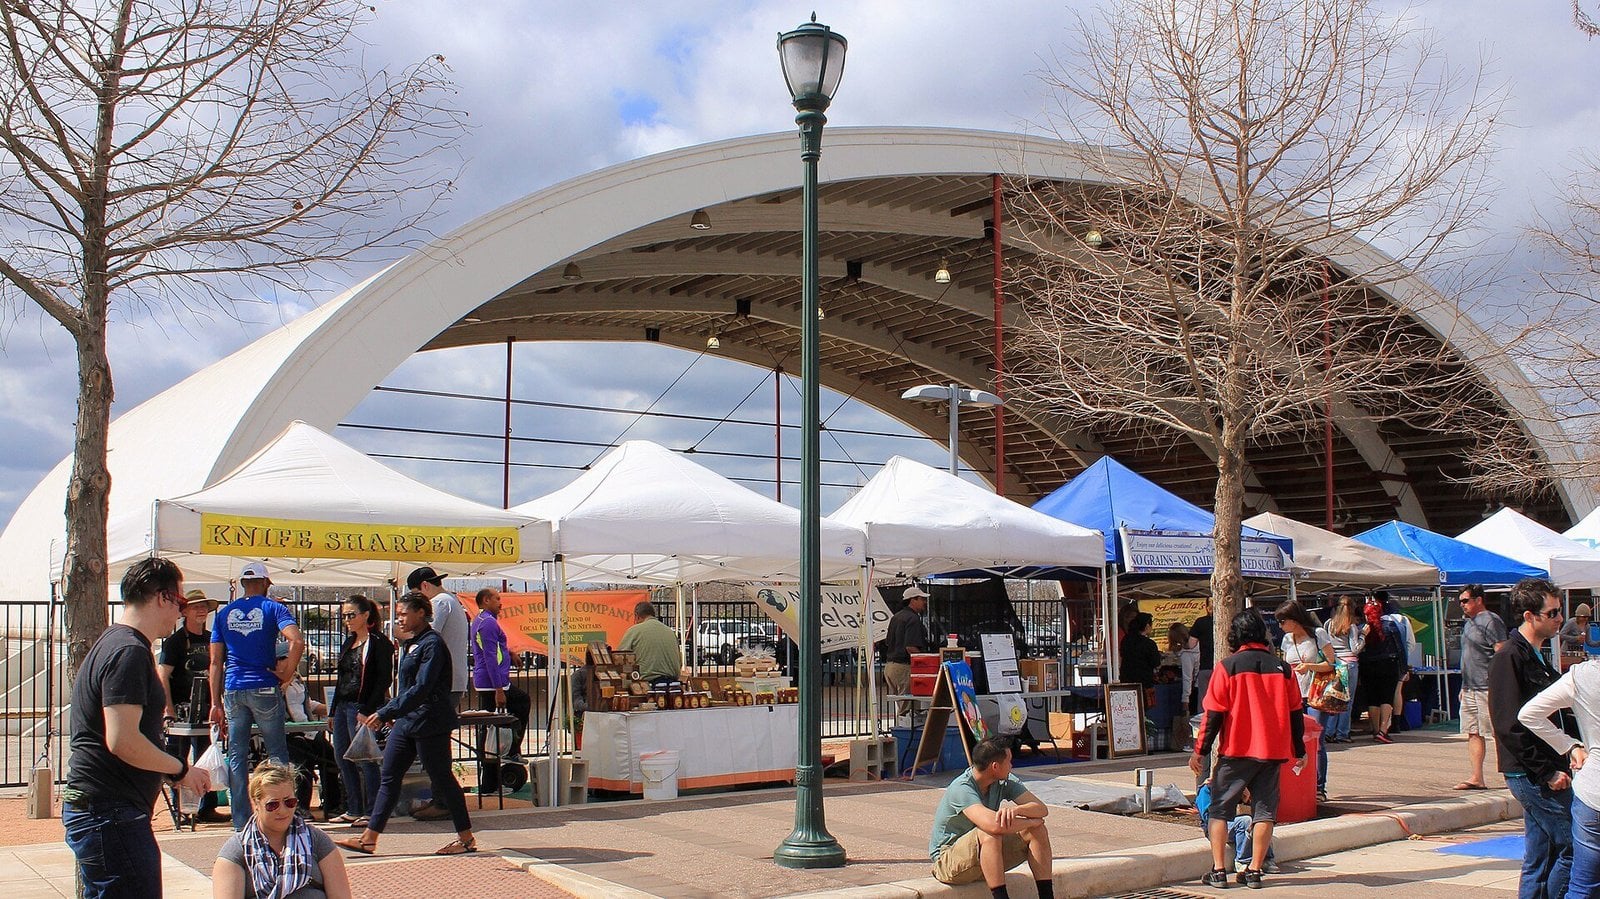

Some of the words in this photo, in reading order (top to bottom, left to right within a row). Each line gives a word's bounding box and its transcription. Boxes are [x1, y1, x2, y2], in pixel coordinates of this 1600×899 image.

[206, 524, 313, 549] KNIFE
[324, 531, 515, 557] SHARPENING
[1131, 554, 1143, 566] NO
[1192, 556, 1212, 566] DAIR
[1258, 559, 1281, 571] SUGAR
[574, 601, 634, 622] COMPANY
[229, 621, 261, 630] LIONHEART
[519, 624, 538, 632] LOCAL
[578, 622, 602, 630] NECTARS
